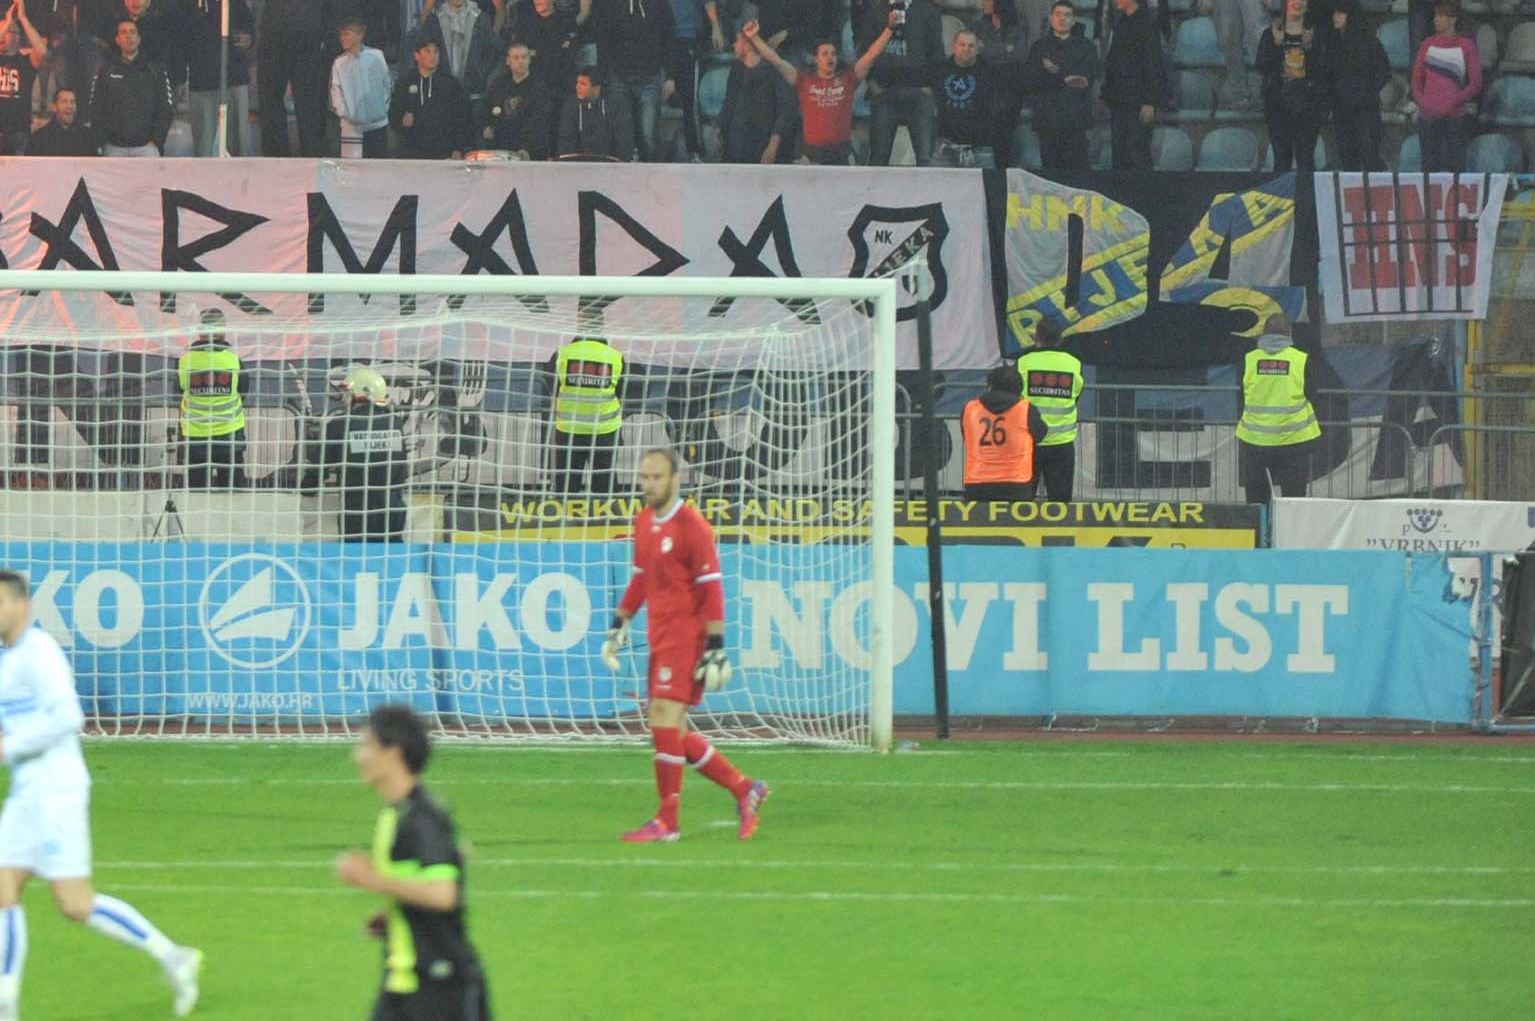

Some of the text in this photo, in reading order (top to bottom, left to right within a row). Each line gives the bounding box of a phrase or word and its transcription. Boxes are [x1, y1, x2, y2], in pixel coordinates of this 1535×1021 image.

[18, 175, 822, 324] ARMADA
[874, 230, 894, 245] NK
[1029, 387, 1071, 396] SECURITAS
[979, 416, 1008, 447] 26
[742, 498, 820, 524] AND
[990, 500, 1205, 523] FOOTWEAR
[337, 571, 592, 651] JAKO
[741, 580, 1349, 673] NOVI LIST
[337, 669, 525, 692] LIVING SPORTS
[186, 693, 313, 709] WWW.JAKO.HR
